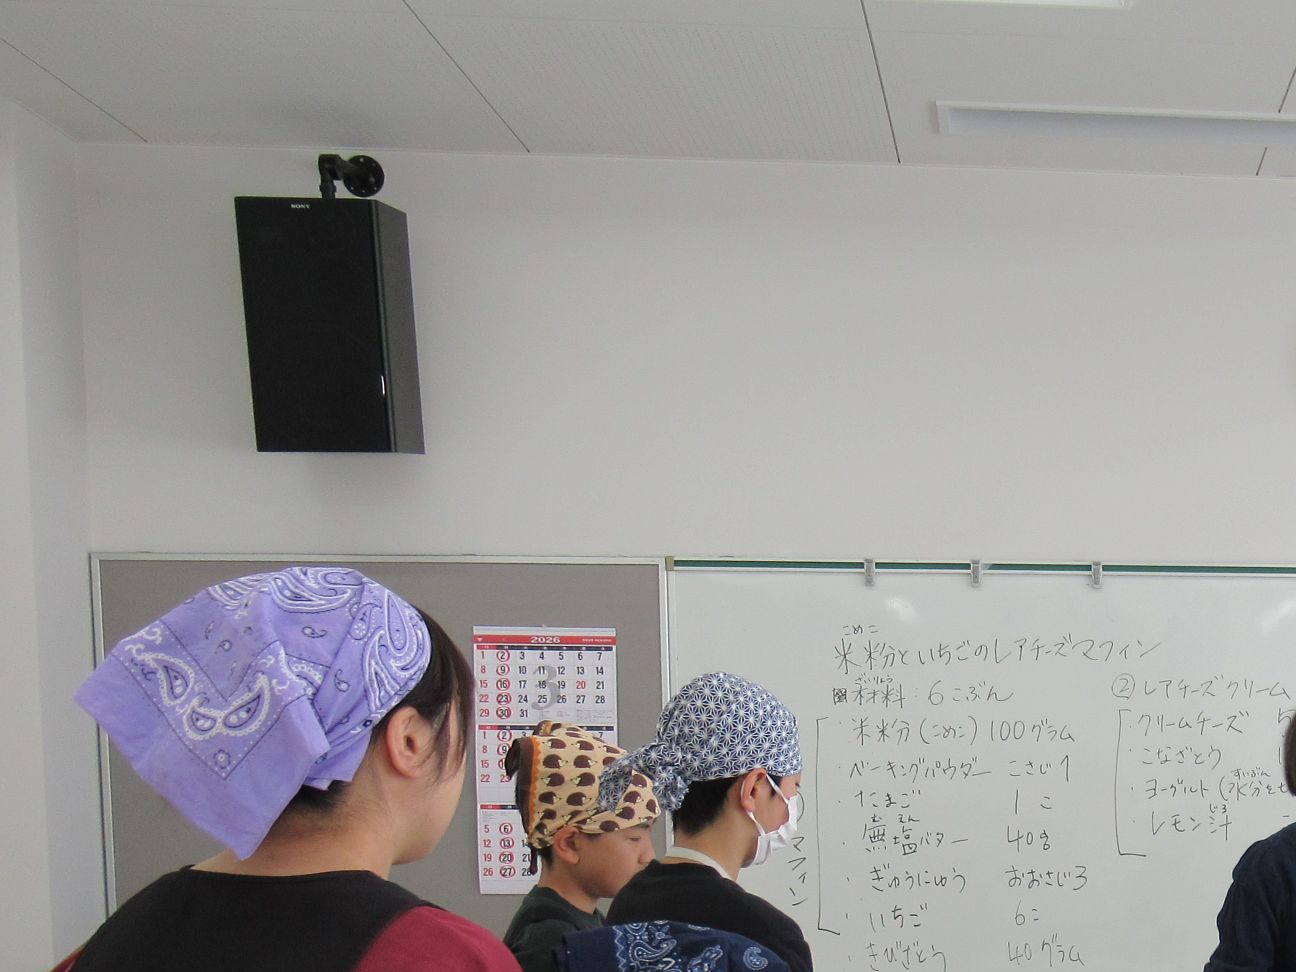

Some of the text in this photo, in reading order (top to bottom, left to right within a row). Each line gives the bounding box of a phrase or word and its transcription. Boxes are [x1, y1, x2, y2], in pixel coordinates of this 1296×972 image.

[842, 624, 879, 635] こめこ
[530, 636, 560, 644] 2026
[481, 651, 602, 660] 1 2 3 4 5 6 7
[834, 634, 1161, 675] 米粉といちごのレアチーズマフィン
[480, 665, 486, 673] 8
[500, 666, 506, 674] 9
[518, 666, 526, 674] 10
[557, 666, 565, 675] 12
[576, 667, 585, 675] 13
[596, 667, 604, 675] 14
[479, 680, 488, 688] 15
[499, 680, 507, 688] 16
[518, 680, 526, 689] 17
[557, 681, 566, 689] 19
[576, 681, 586, 689] 20
[596, 681, 605, 689] 21
[479, 694, 605, 704] 22 23 24 25 26 27 28
[479, 709, 489, 717] 29
[499, 709, 508, 717] 30
[519, 709, 528, 717] 31
[1138, 711, 1250, 736] クリームチーズ
[482, 731, 486, 739] 1
[501, 731, 507, 739] 2
[482, 746, 507, 754] 8 9
[1142, 745, 1222, 770] こなざとう
[480, 760, 505, 768] 15 1
[850, 756, 992, 783] ベーキングパウダー
[480, 774, 510, 782] 22 23
[853, 790, 921, 809] たまご
[484, 825, 509, 833] 5 6
[1152, 811, 1233, 841] レモン汁
[483, 840, 491, 848] 12
[502, 840, 510, 848] 13
[862, 824, 968, 856] 無塩バター
[484, 854, 492, 862] 19
[502, 854, 511, 862] 20
[483, 868, 493, 876] 26
[502, 868, 512, 876] 27
[869, 863, 1088, 893] ぎゅうにゅう おおさじ3
[869, 903, 928, 933] いちご
